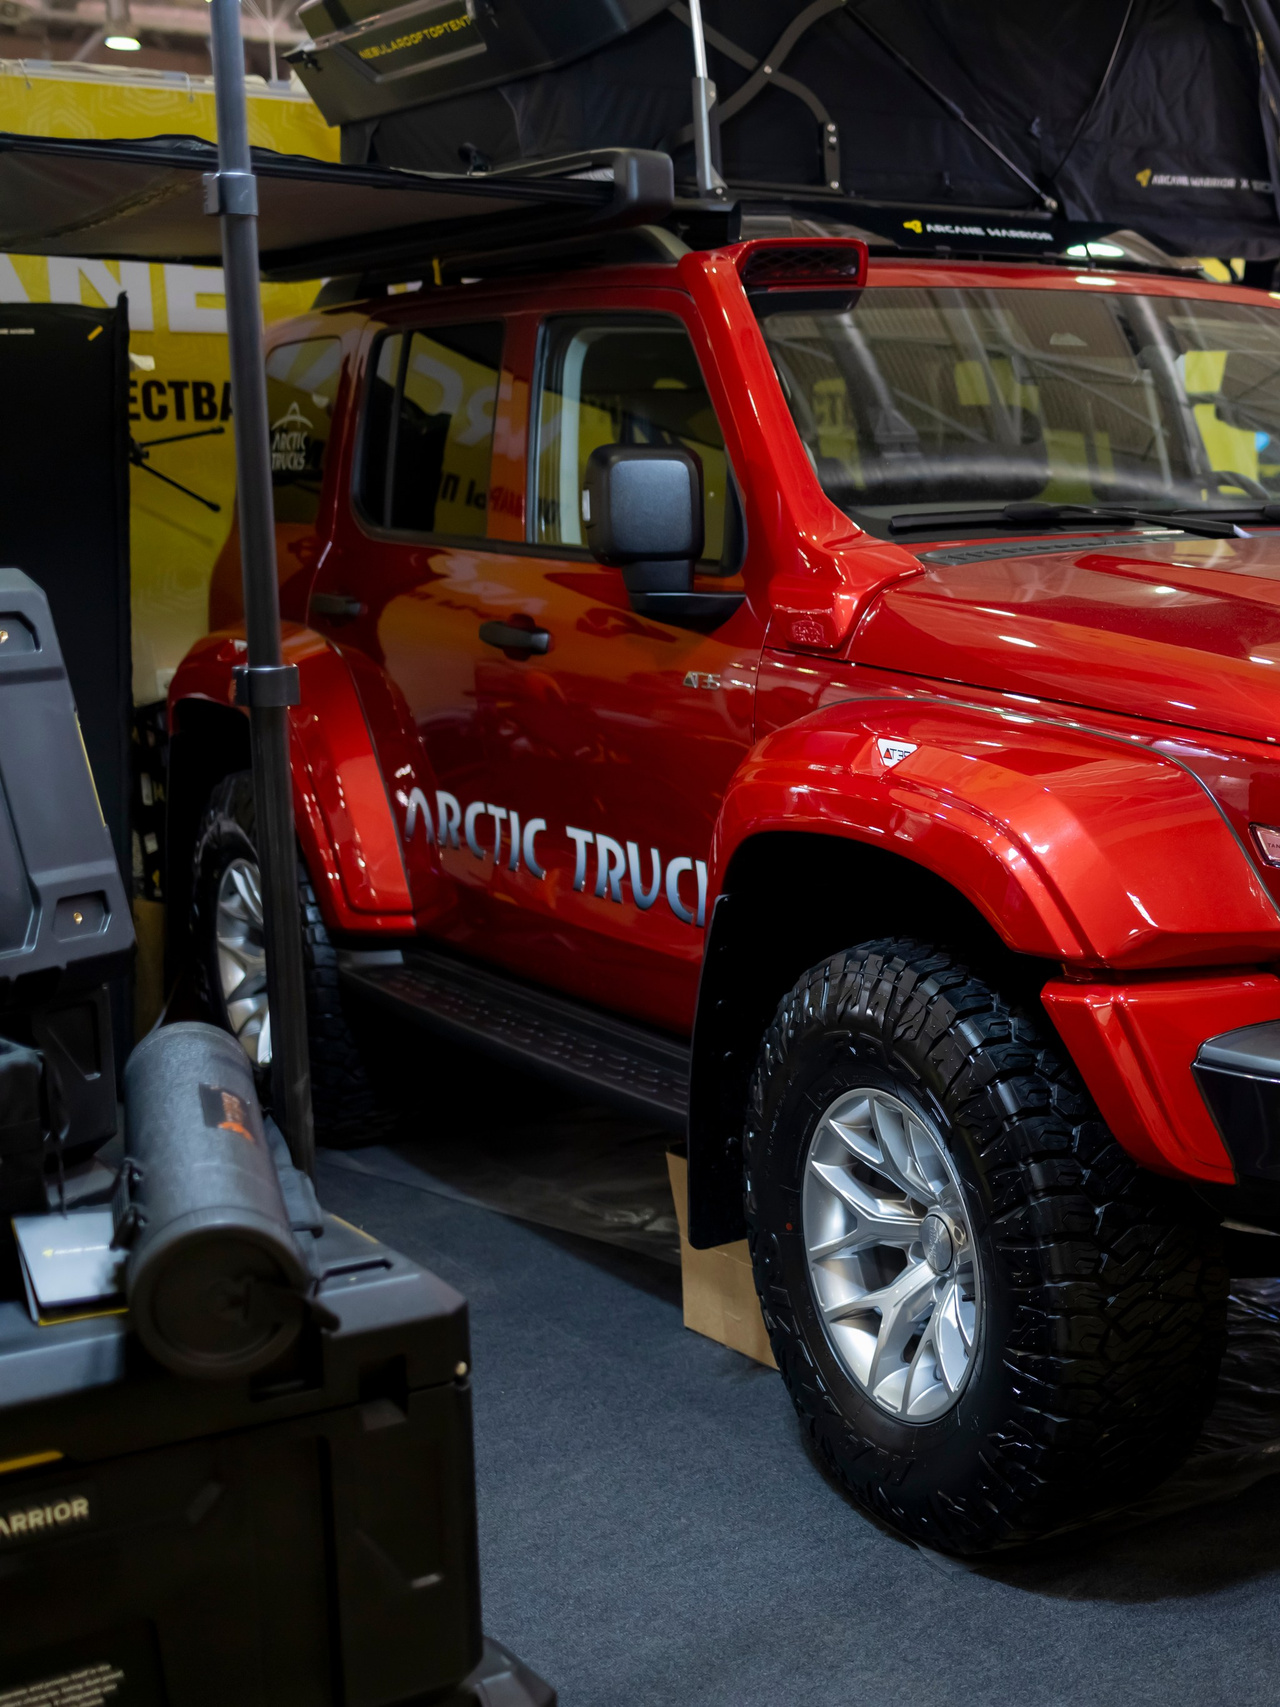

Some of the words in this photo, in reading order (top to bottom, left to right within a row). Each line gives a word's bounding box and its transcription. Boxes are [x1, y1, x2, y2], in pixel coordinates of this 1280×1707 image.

[925, 223, 986, 236] ARCANE
[986, 228, 1054, 242] WARRIOR
[404, 786, 547, 881] ARCTIC
